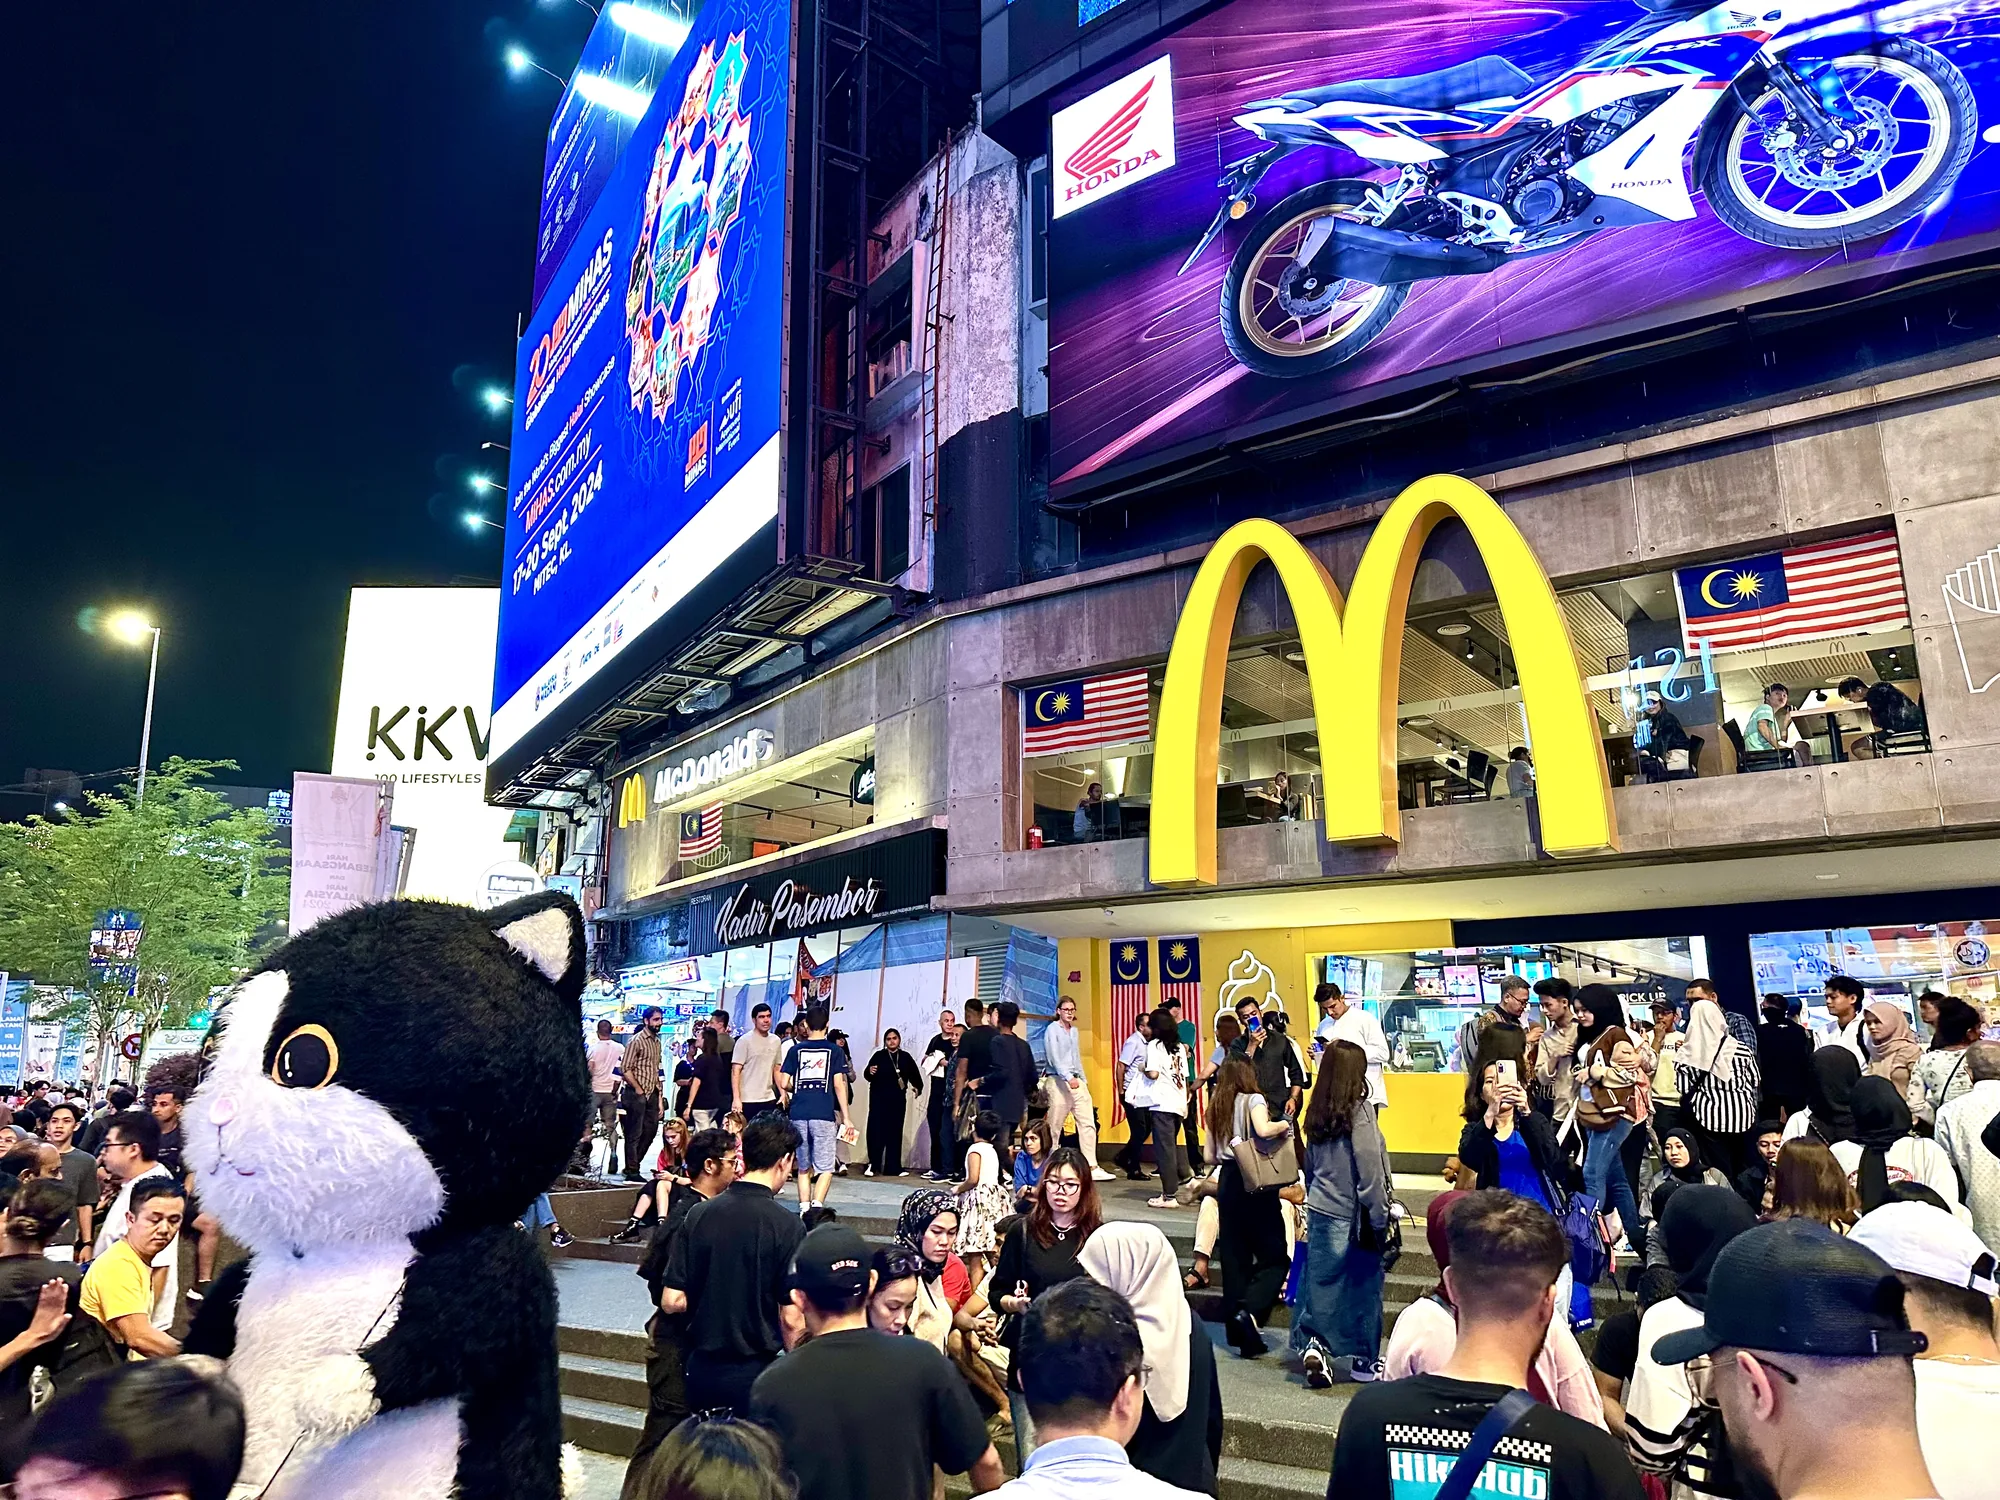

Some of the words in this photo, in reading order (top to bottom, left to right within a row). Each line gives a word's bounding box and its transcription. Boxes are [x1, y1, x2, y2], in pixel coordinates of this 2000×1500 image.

[1064, 148, 1162, 202] HONDA
[1610, 178, 1673, 189] HONDA
[566, 227, 613, 330] MIHAS
[556, 347, 571, 383] Halal
[549, 421, 569, 460] Biggest
[569, 397, 584, 431] Halal
[583, 355, 615, 408] Showcase
[525, 428, 592, 532] MIHAS.com.my
[684, 453, 707, 489] MIHAS
[512, 543, 540, 596] 17-20
[570, 459, 603, 526] 2024
[401, 773, 482, 784] LIFESTYLES
[653, 728, 774, 804] McDonald's
[713, 882, 768, 945] Kadir
[768, 875, 880, 937] Pasembor
[1619, 992, 1646, 1003] PICK
[1648, 992, 1666, 1003] UP
[1389, 1450, 1457, 1483] Hik
[1472, 1460, 1548, 1500] Hub
